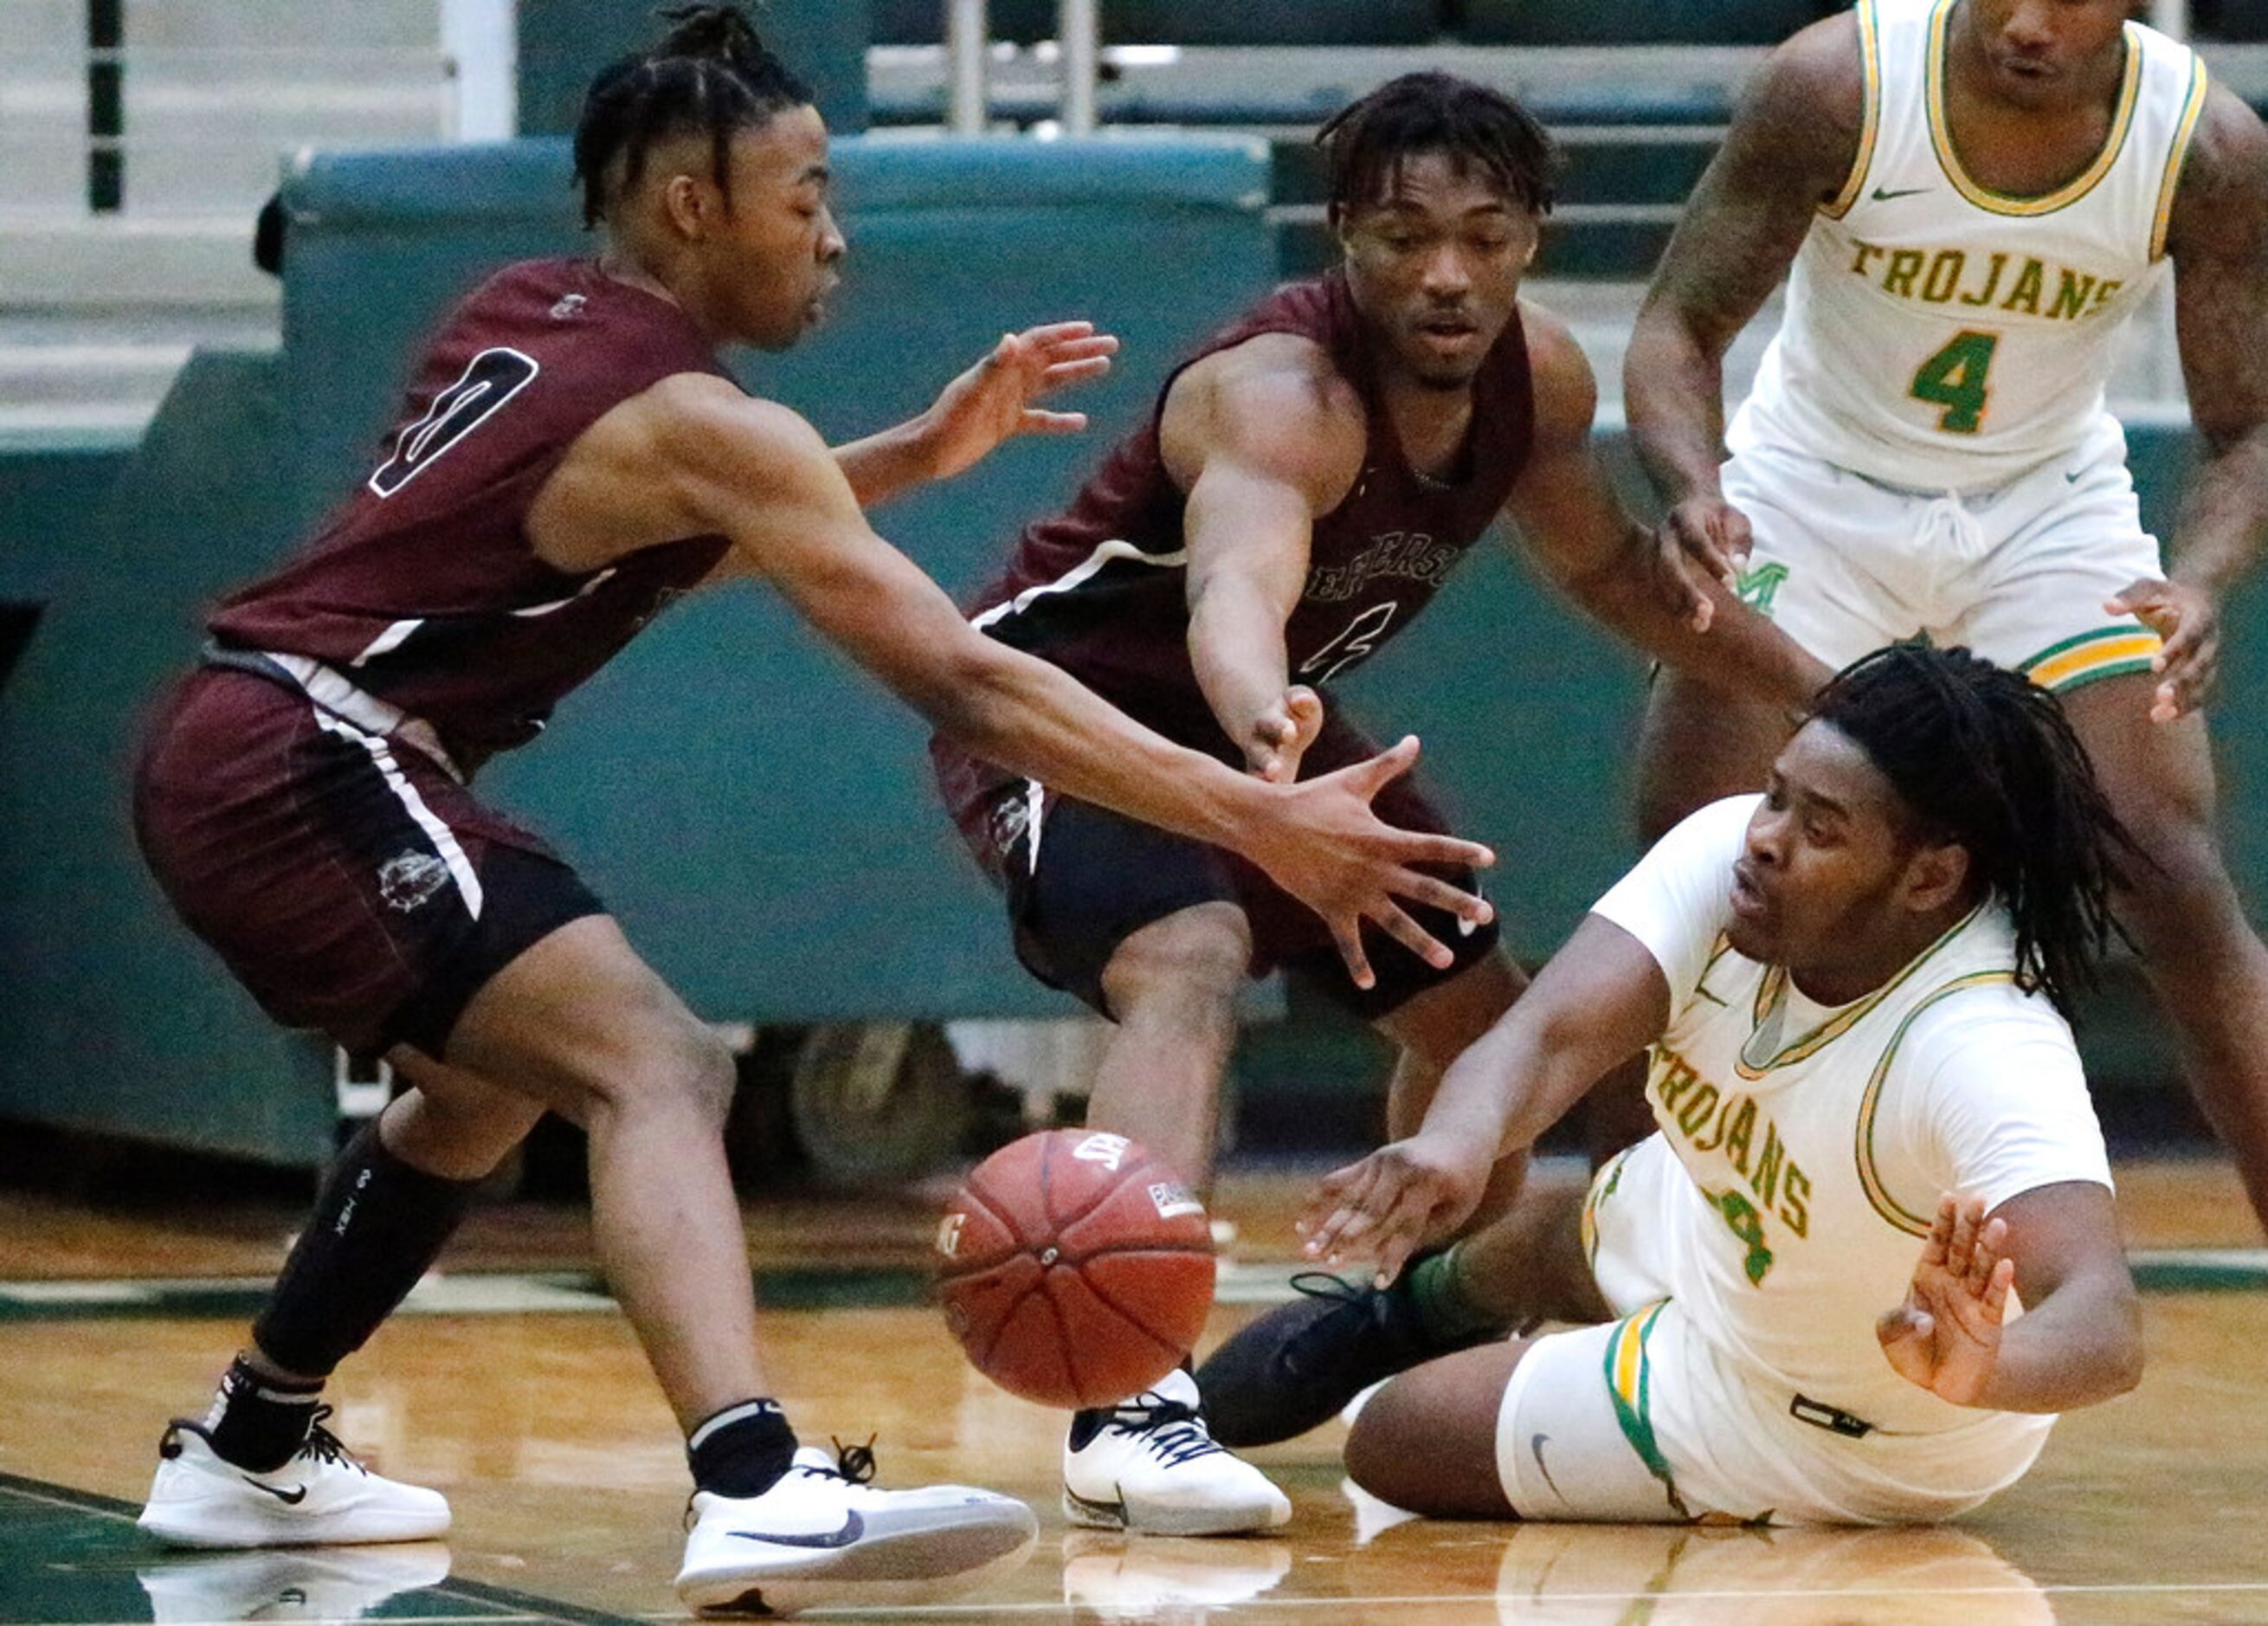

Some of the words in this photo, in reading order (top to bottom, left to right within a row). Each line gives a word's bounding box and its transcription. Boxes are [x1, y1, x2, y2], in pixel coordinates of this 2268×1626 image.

[1851, 238, 2124, 320] TROJANS
[368, 346, 539, 499] 0
[1910, 328, 1999, 434] 4
